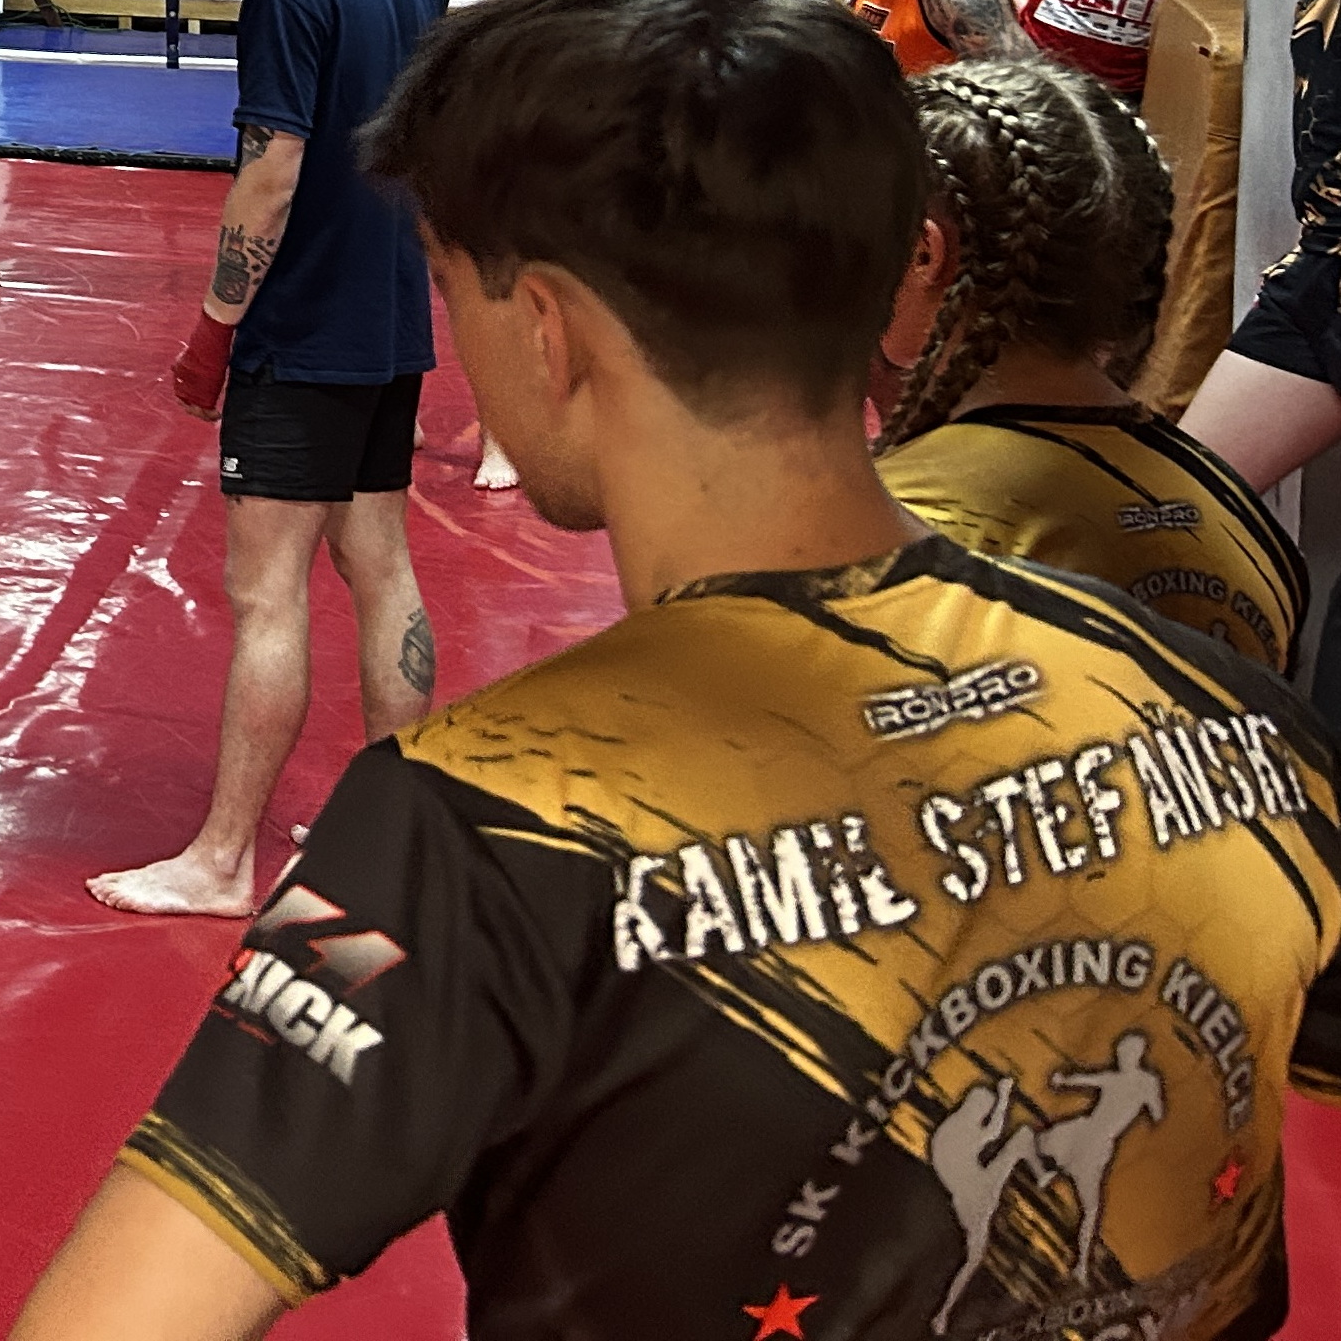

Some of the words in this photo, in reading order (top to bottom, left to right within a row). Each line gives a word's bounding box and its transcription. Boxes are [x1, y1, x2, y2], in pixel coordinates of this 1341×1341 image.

[611, 813, 918, 973] KAMIL
[768, 1177, 843, 1260] SK
[827, 937, 1153, 1170] KICKBOXING
[1157, 967, 1256, 1133] KIELCE
